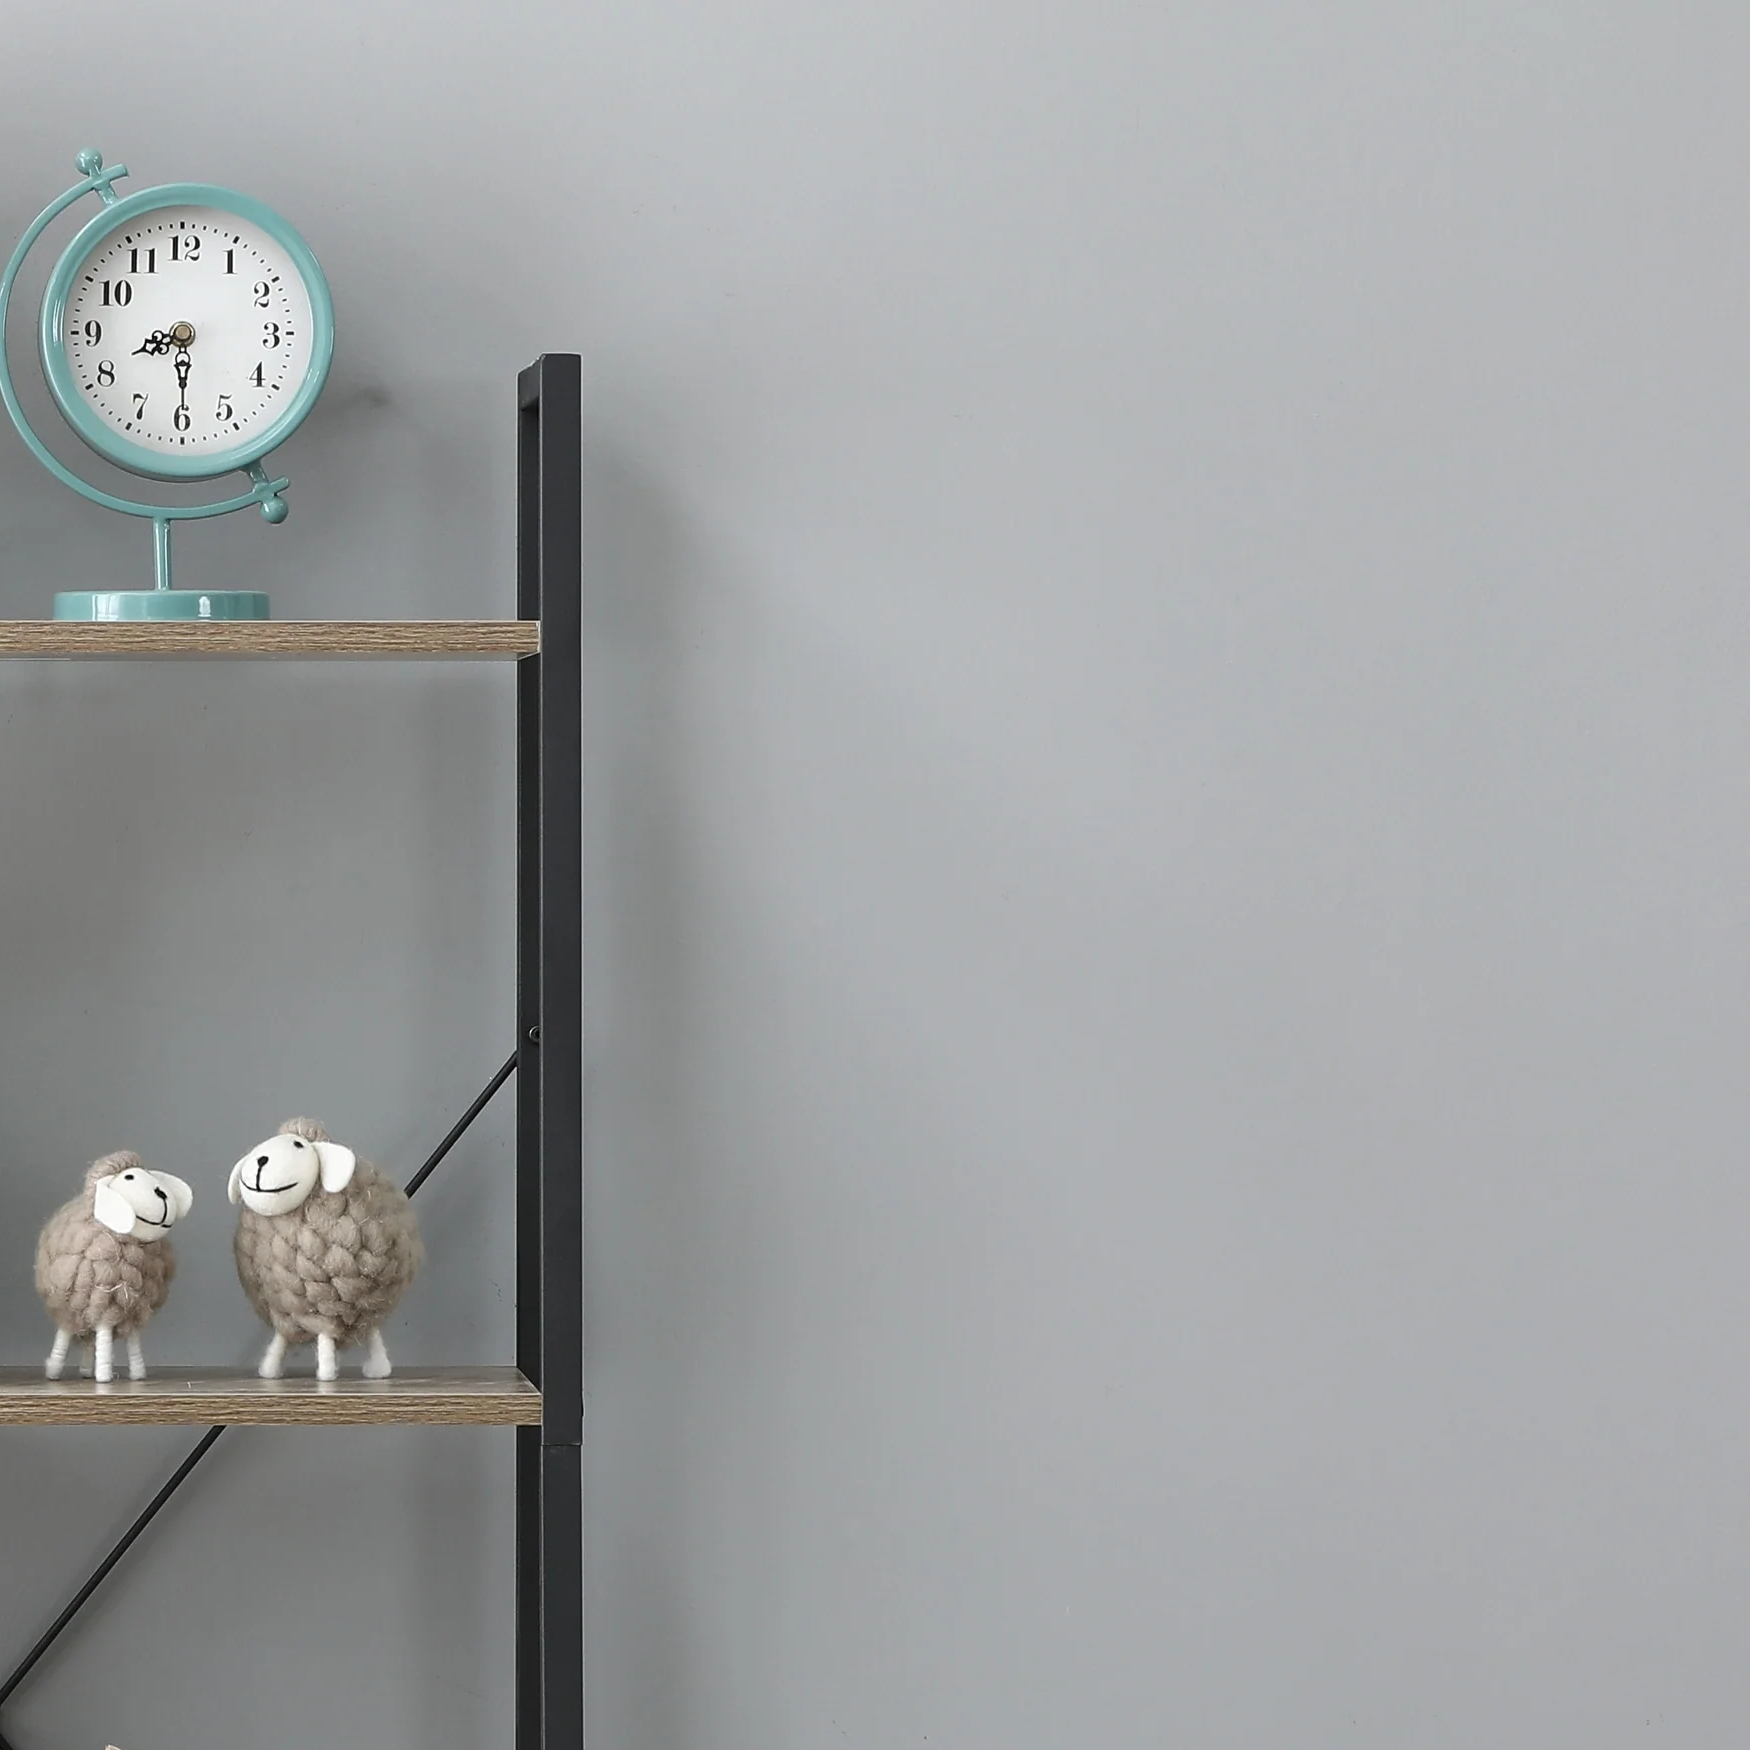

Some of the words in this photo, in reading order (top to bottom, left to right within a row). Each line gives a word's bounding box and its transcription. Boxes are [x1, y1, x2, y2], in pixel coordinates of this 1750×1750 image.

[127, 248, 158, 274] 11
[167, 235, 201, 261] 12
[223, 249, 238, 275] 1
[99, 280, 133, 307] 10
[253, 281, 271, 308] 2
[84, 320, 102, 347] 9
[262, 322, 280, 349] 3
[97, 360, 115, 387] 8
[248, 361, 266, 388] 4
[132, 393, 149, 420] 7
[173, 404, 191, 431] 6
[216, 394, 232, 421] 5
